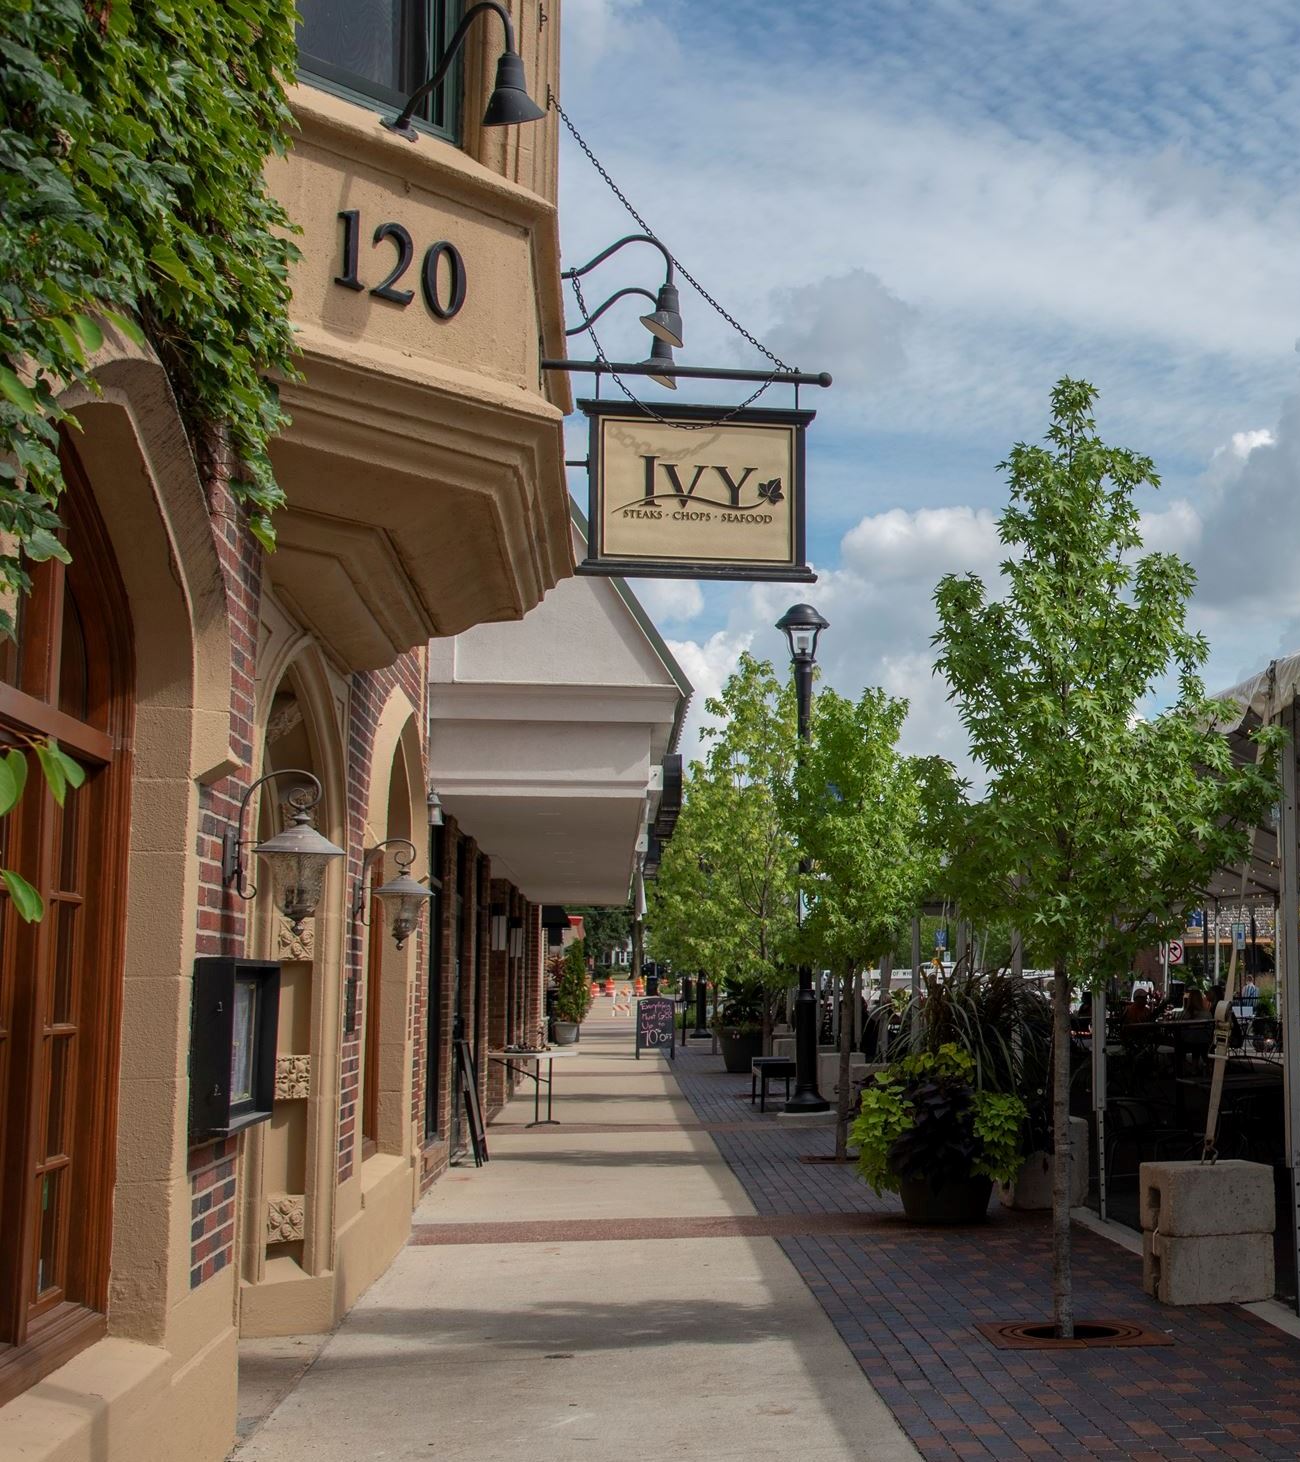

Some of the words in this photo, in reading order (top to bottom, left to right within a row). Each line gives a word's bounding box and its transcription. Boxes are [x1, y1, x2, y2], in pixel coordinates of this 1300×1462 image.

[334, 209, 467, 319] 120
[638, 454, 758, 508] IVY
[623, 509, 662, 520] STEAKS
[672, 511, 711, 523] CHOPS
[721, 512, 773, 525] SEAFOOD
